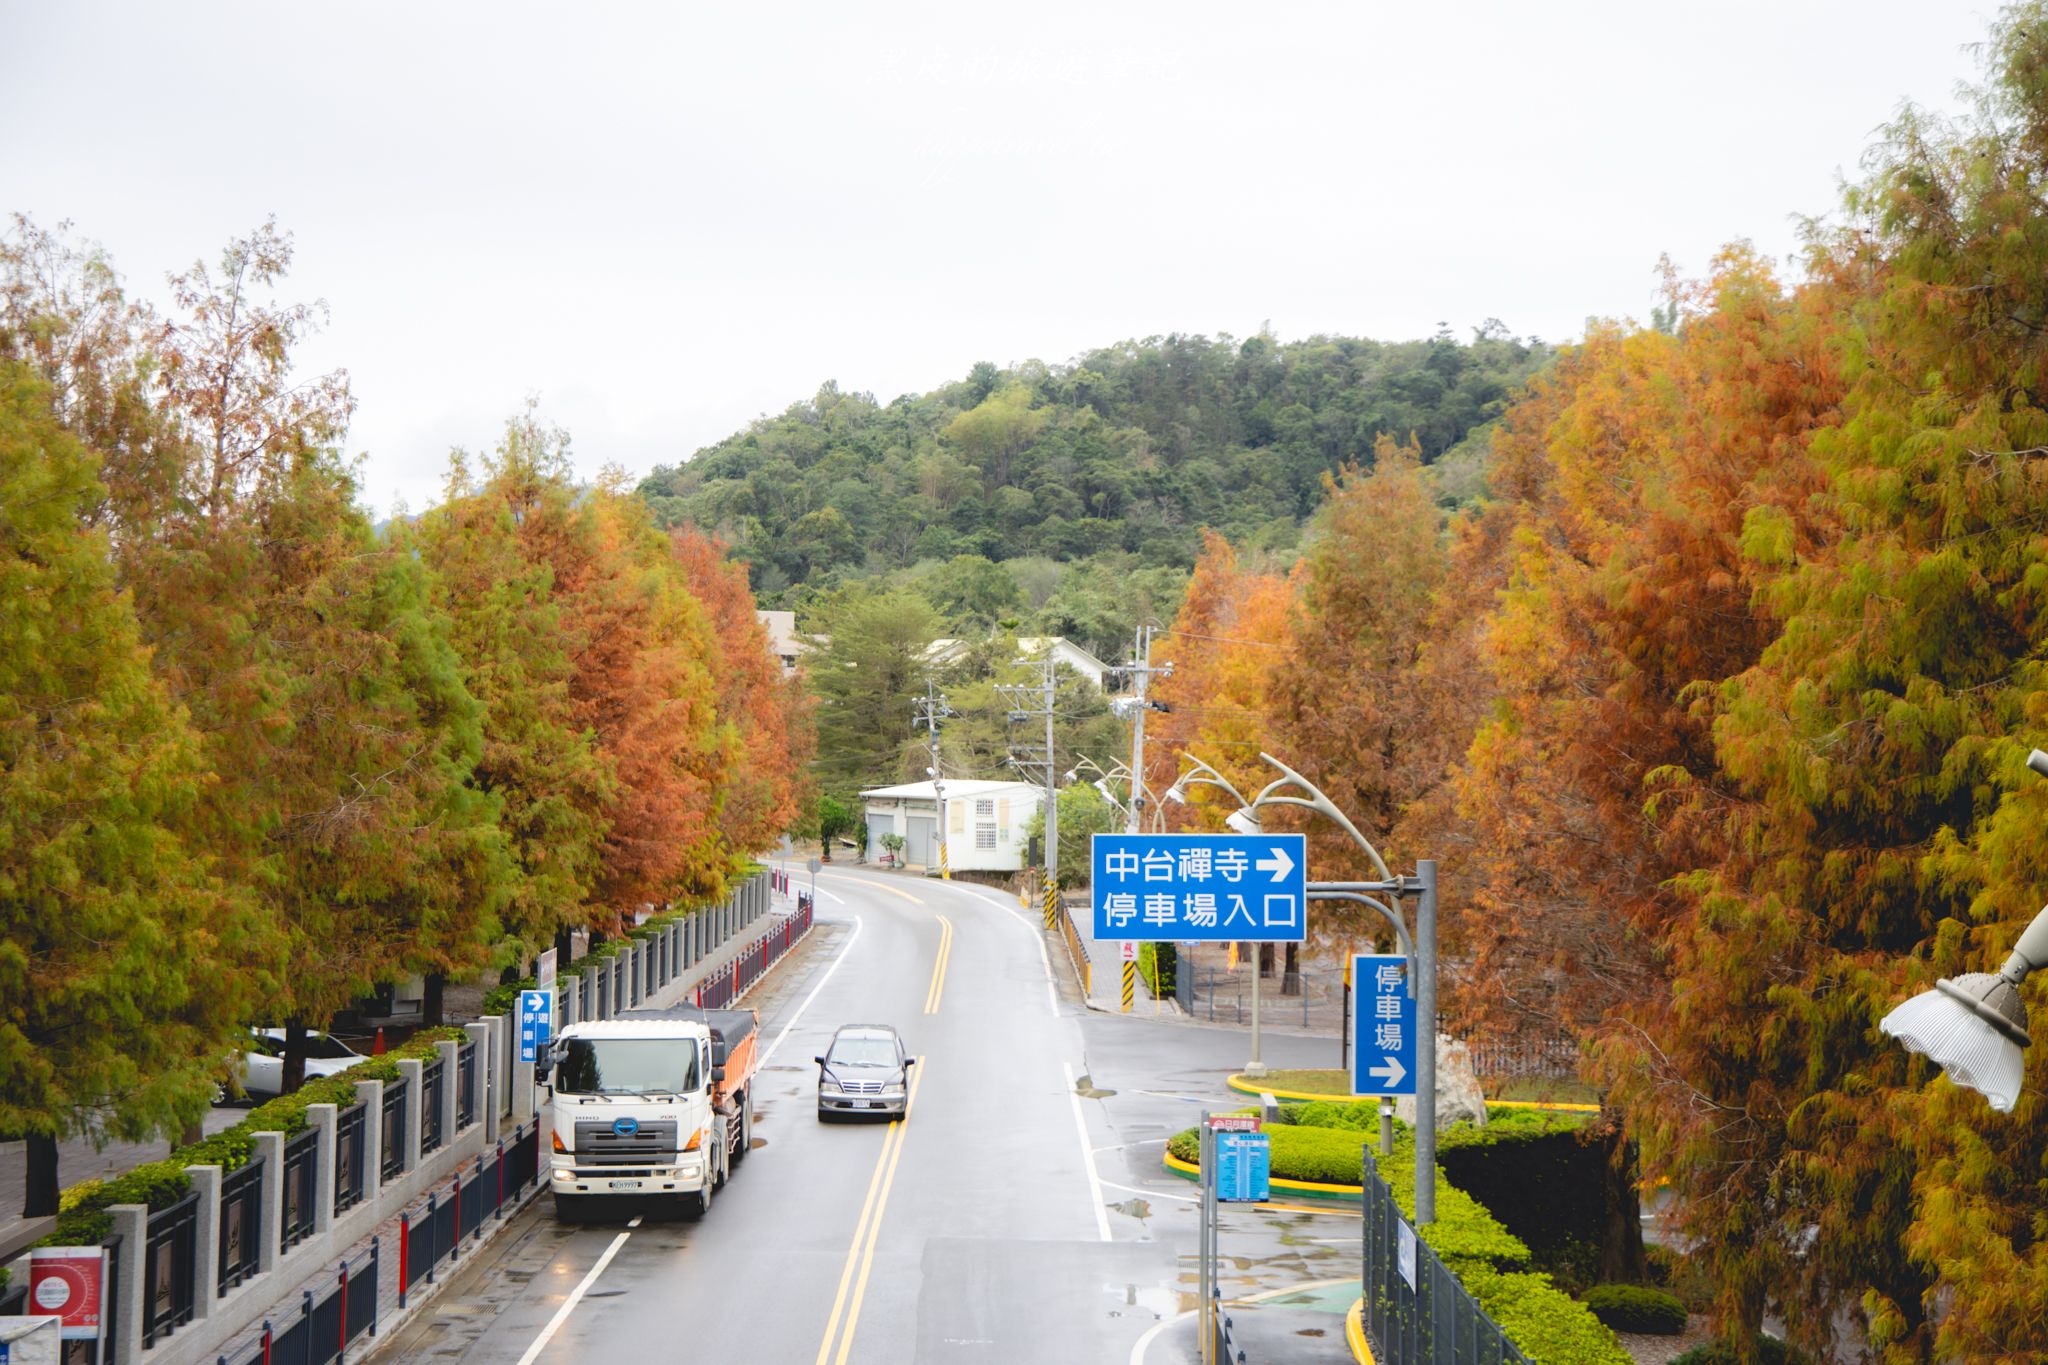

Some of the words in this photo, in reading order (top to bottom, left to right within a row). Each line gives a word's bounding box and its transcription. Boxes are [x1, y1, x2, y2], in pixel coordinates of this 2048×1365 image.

[1105, 847, 1249, 883] 中台禪寺
[1103, 892, 1296, 928] 停車場入口
[1374, 964, 1403, 1051] 停車場
[522, 1012, 535, 1059] 停車場
